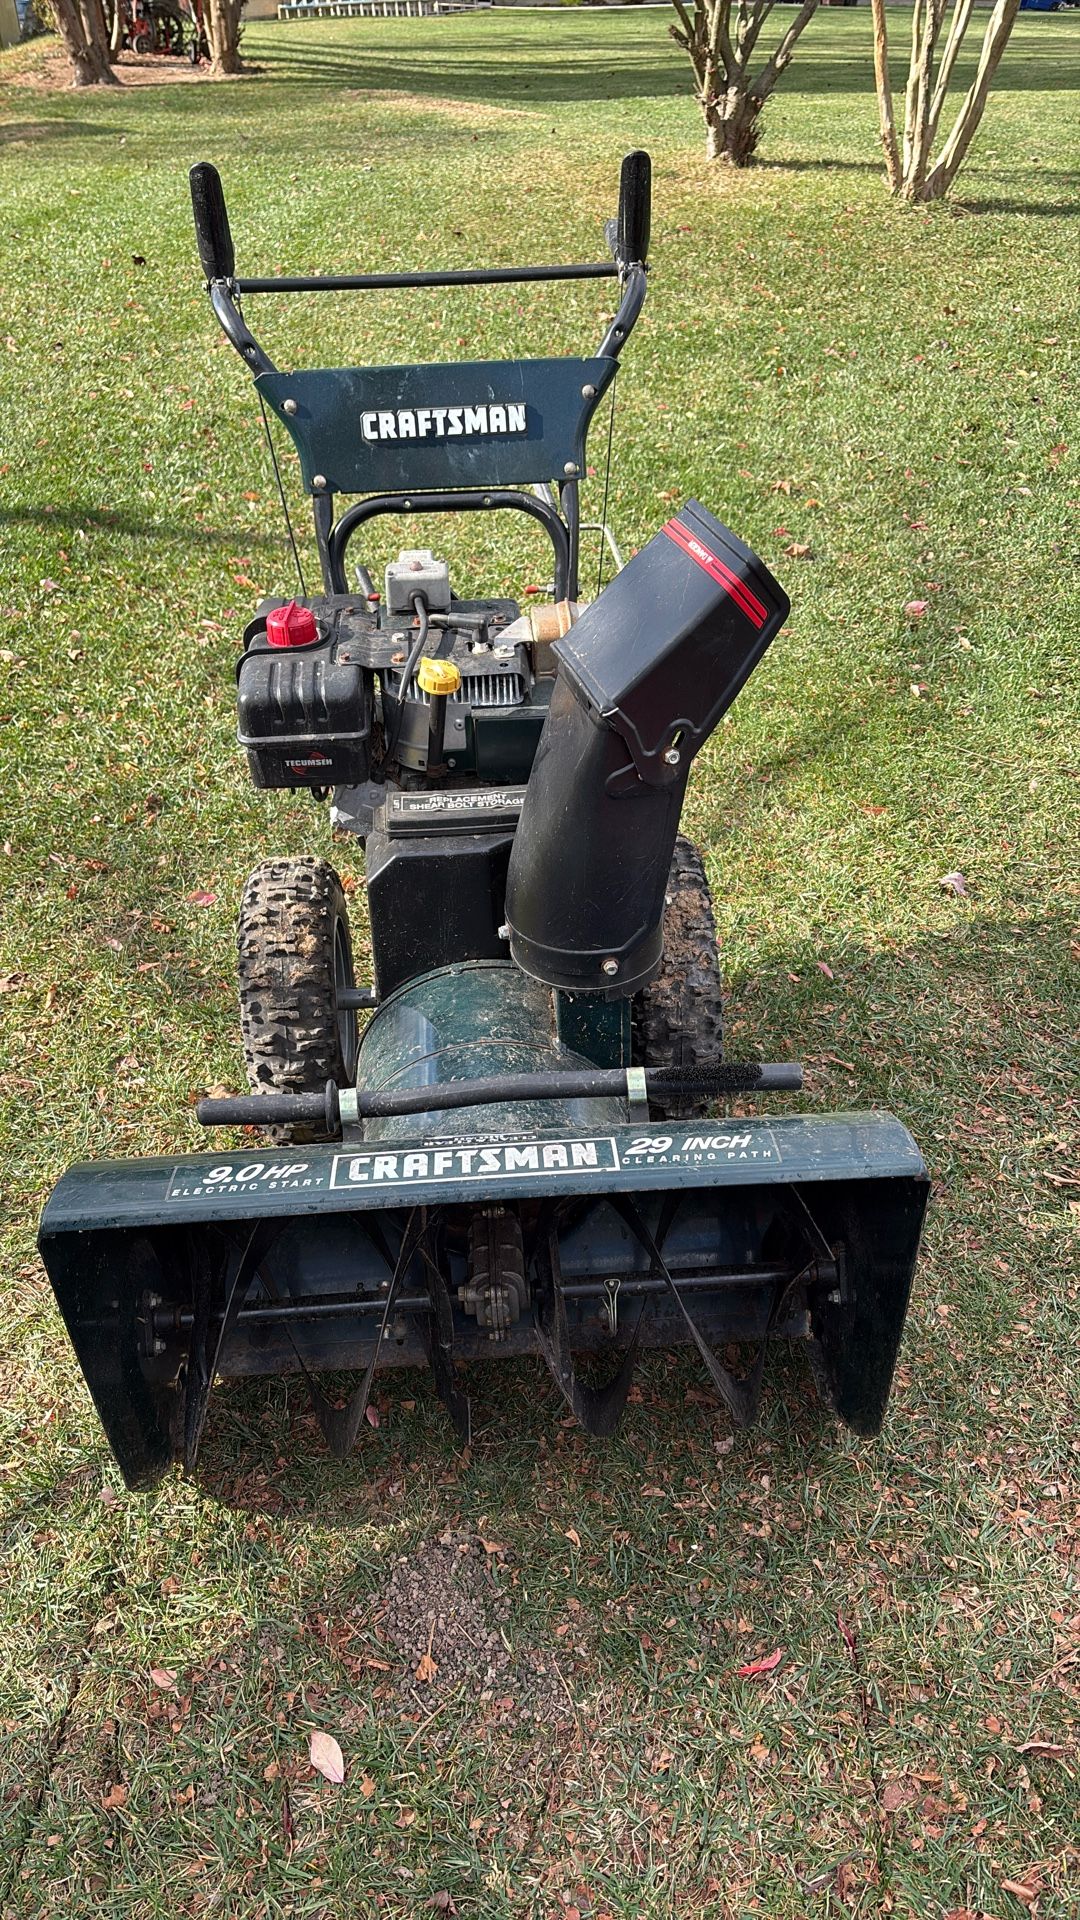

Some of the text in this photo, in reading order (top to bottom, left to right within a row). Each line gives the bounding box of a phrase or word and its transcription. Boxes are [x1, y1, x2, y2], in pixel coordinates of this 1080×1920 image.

[362, 405, 526, 440] CRAFTSMAN
[285, 759, 333, 767] TECUMSEH
[409, 801, 445, 810] SHEAR
[447, 801, 473, 809] BOLT
[429, 793, 507, 803] REPLACEMENT
[625, 1134, 752, 1155] 29 INCH
[348, 1142, 598, 1182] CRAFTSMAN
[622, 1150, 772, 1165] CLEARING PATH
[202, 1163, 309, 1185] 9.0 HP
[171, 1177, 324, 1197] ELECTRIC START
